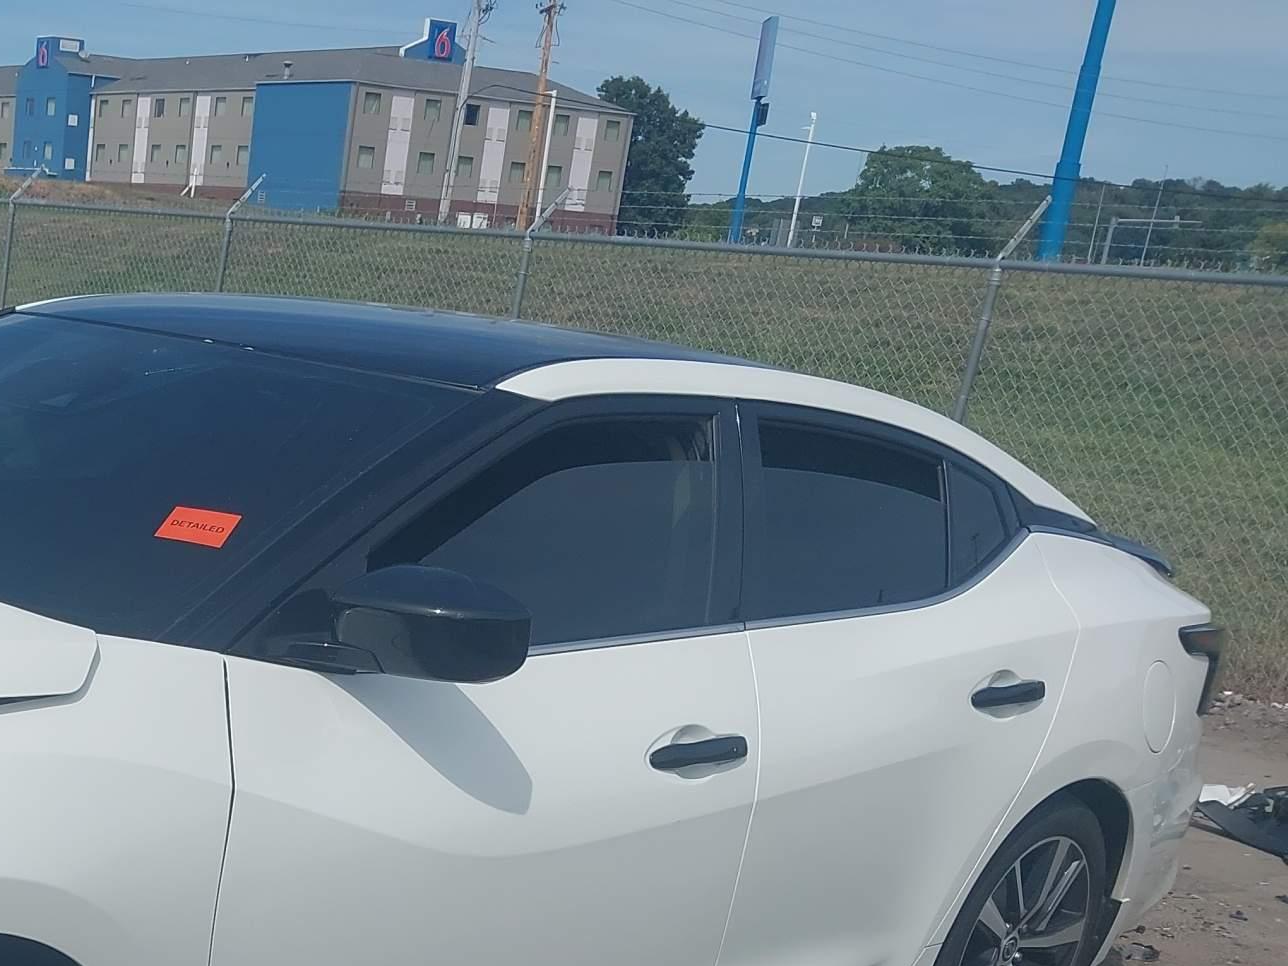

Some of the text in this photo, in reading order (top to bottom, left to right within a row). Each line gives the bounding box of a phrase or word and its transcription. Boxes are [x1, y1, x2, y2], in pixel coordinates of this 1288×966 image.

[39, 41, 48, 67] 6
[435, 27, 451, 58] 6
[170, 519, 225, 533] DETAILED
